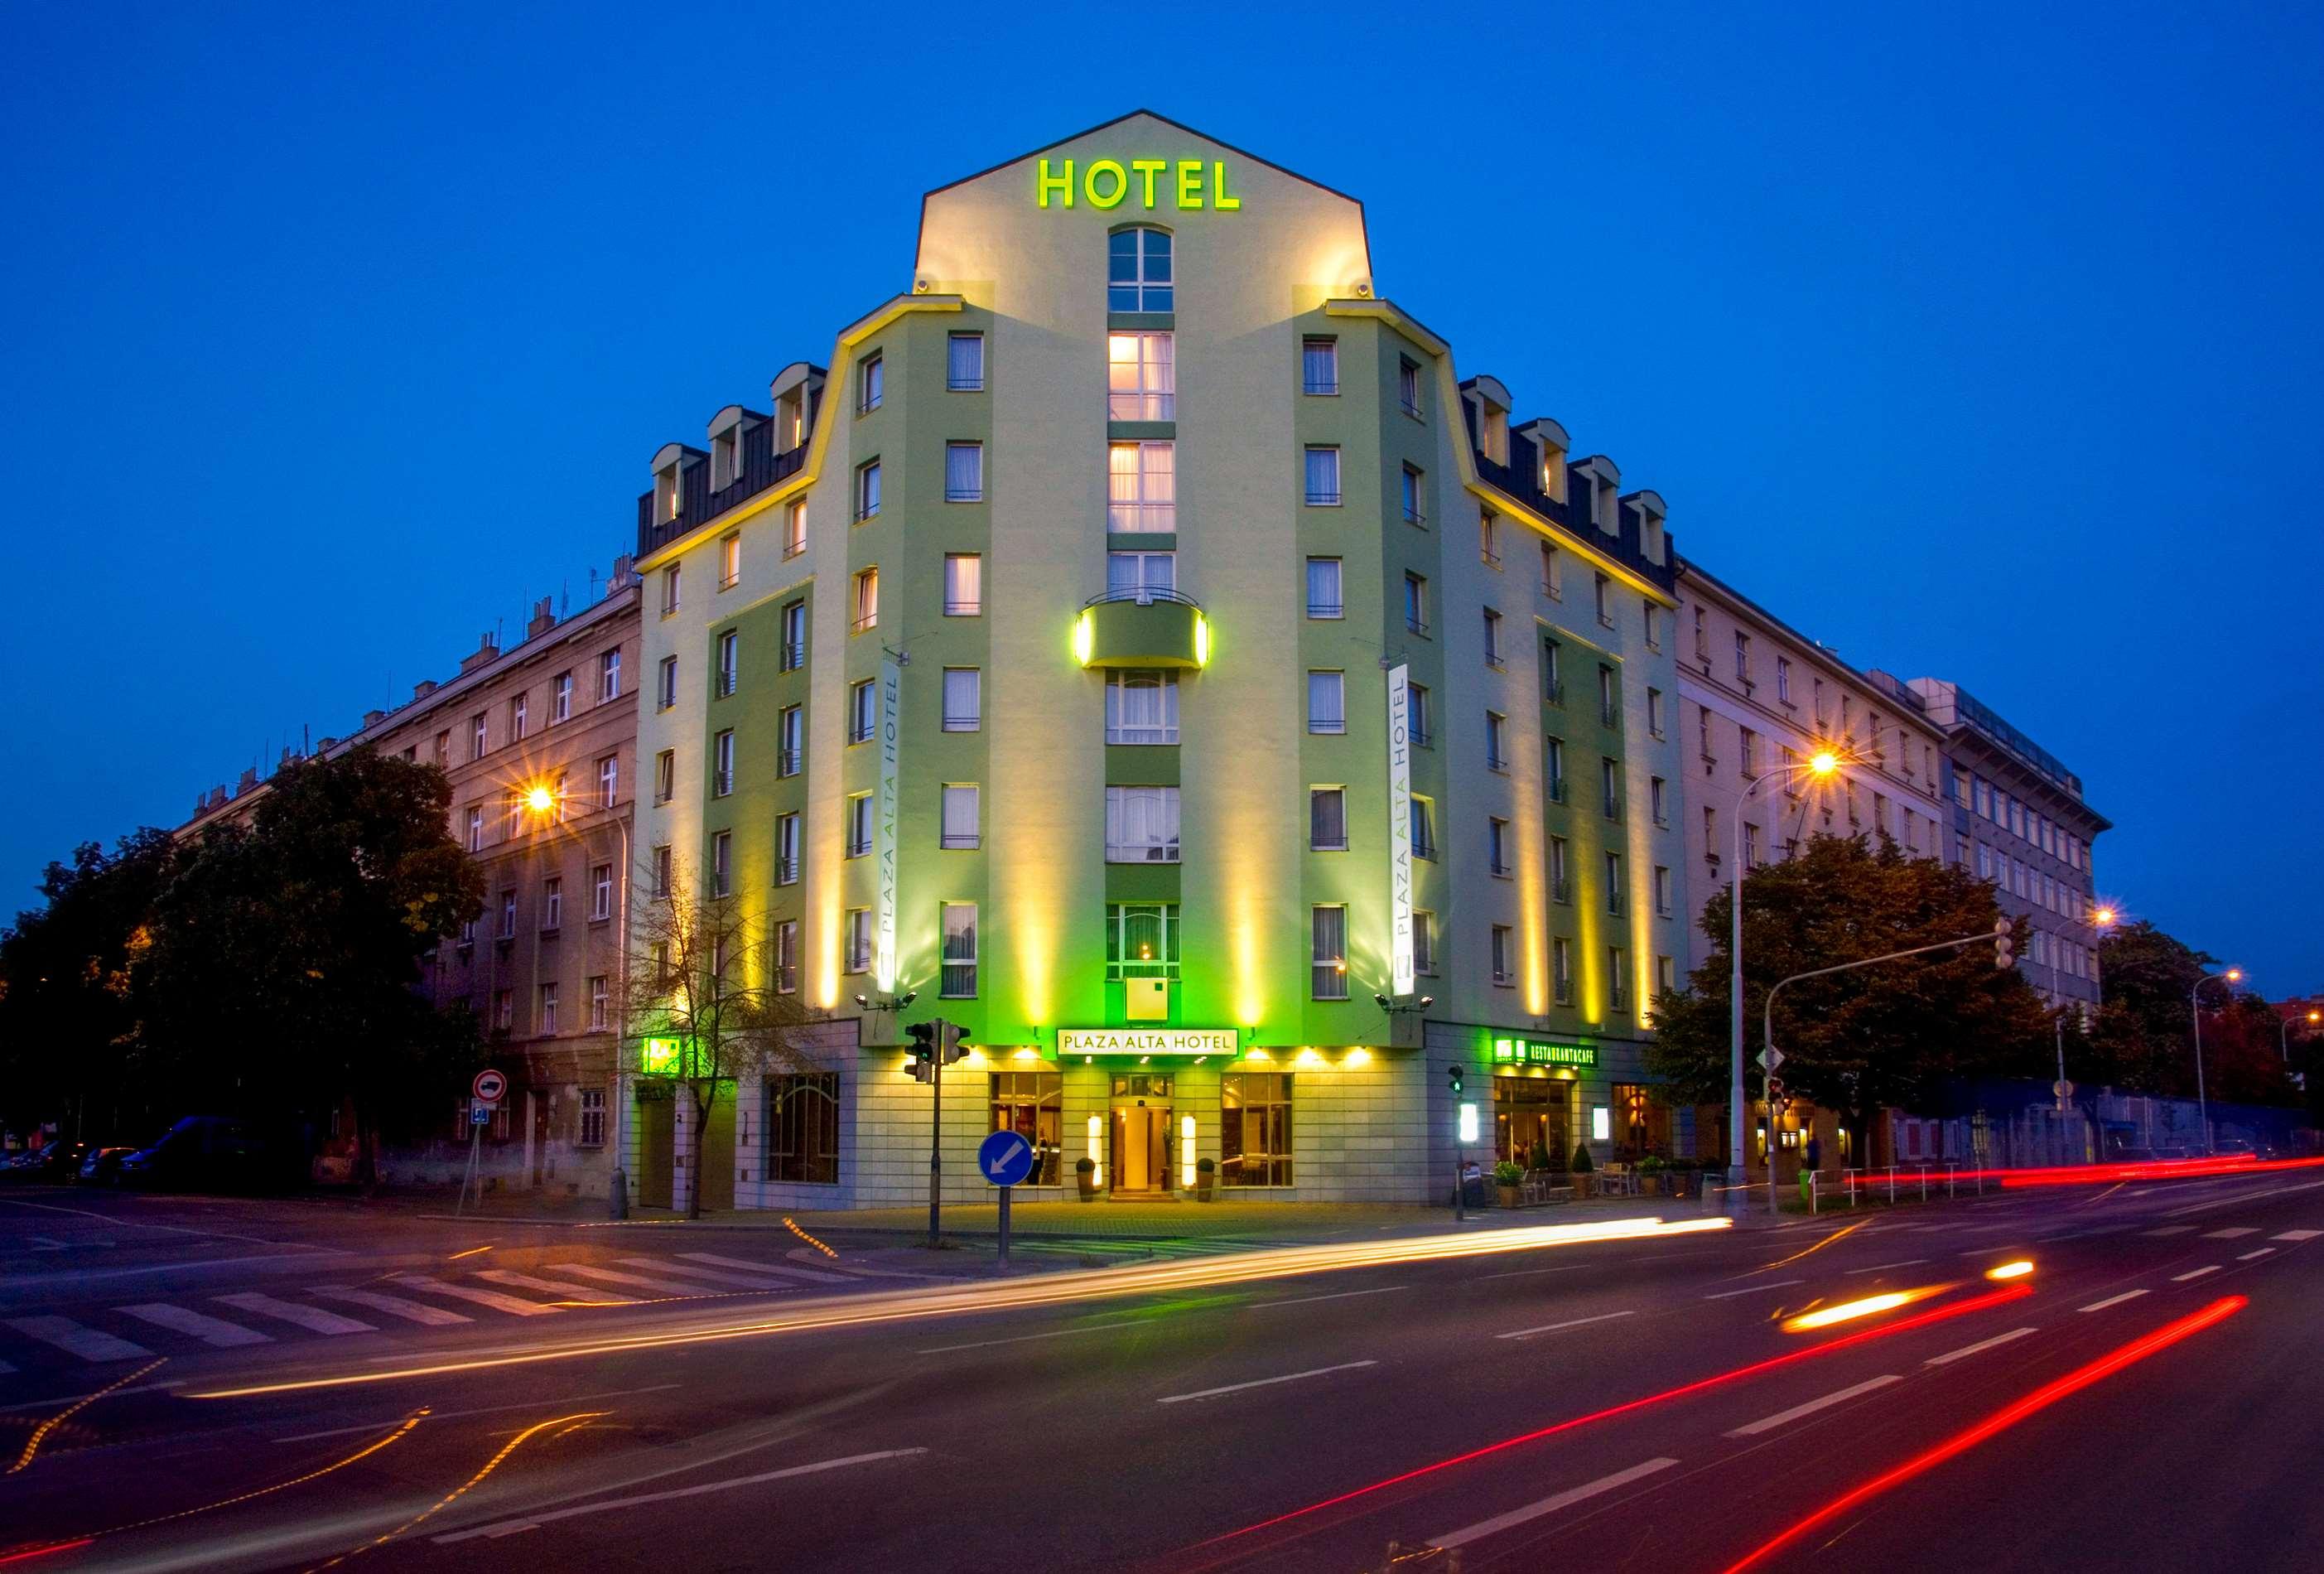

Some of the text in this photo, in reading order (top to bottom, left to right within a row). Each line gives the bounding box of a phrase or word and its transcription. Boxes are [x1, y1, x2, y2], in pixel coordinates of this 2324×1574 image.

[1039, 158, 1240, 210] HOTEL
[881, 676, 897, 934] PLAZA ALTA HOTEL
[1393, 678, 1409, 936] PLAZA ALTA HOTEL
[1064, 1036, 1231, 1048] PLAZA ALTA HOTEL
